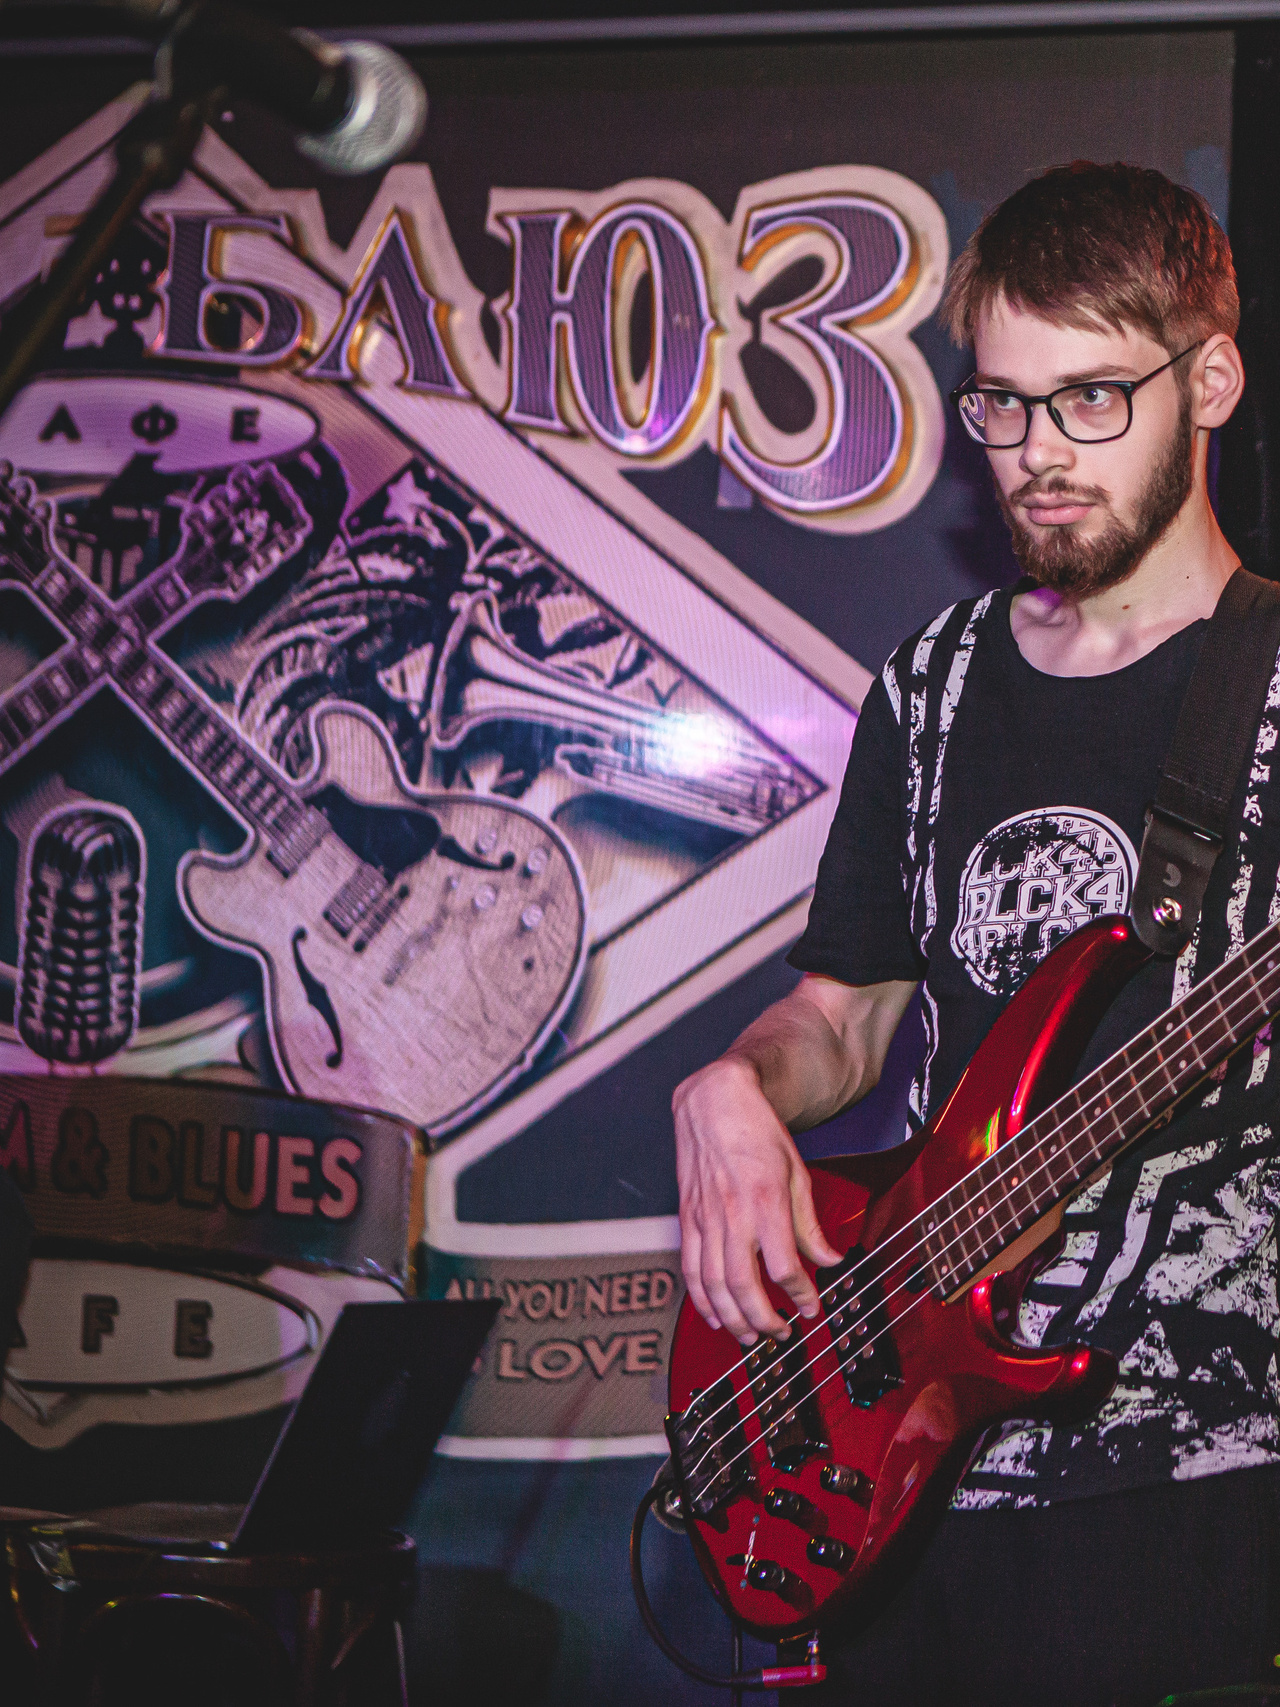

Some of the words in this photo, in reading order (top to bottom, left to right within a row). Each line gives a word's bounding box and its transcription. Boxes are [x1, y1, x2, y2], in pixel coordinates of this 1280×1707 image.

[143, 194, 924, 512] БЛЮЗ
[964, 872, 1123, 926] BLCK4
[51, 1106, 108, 1198] &
[128, 1114, 362, 1221] BLUES
[502, 1279, 578, 1320] YOU
[580, 1269, 676, 1318] NEED
[6, 1294, 213, 1358] FE
[497, 1330, 663, 1382] LOVE
